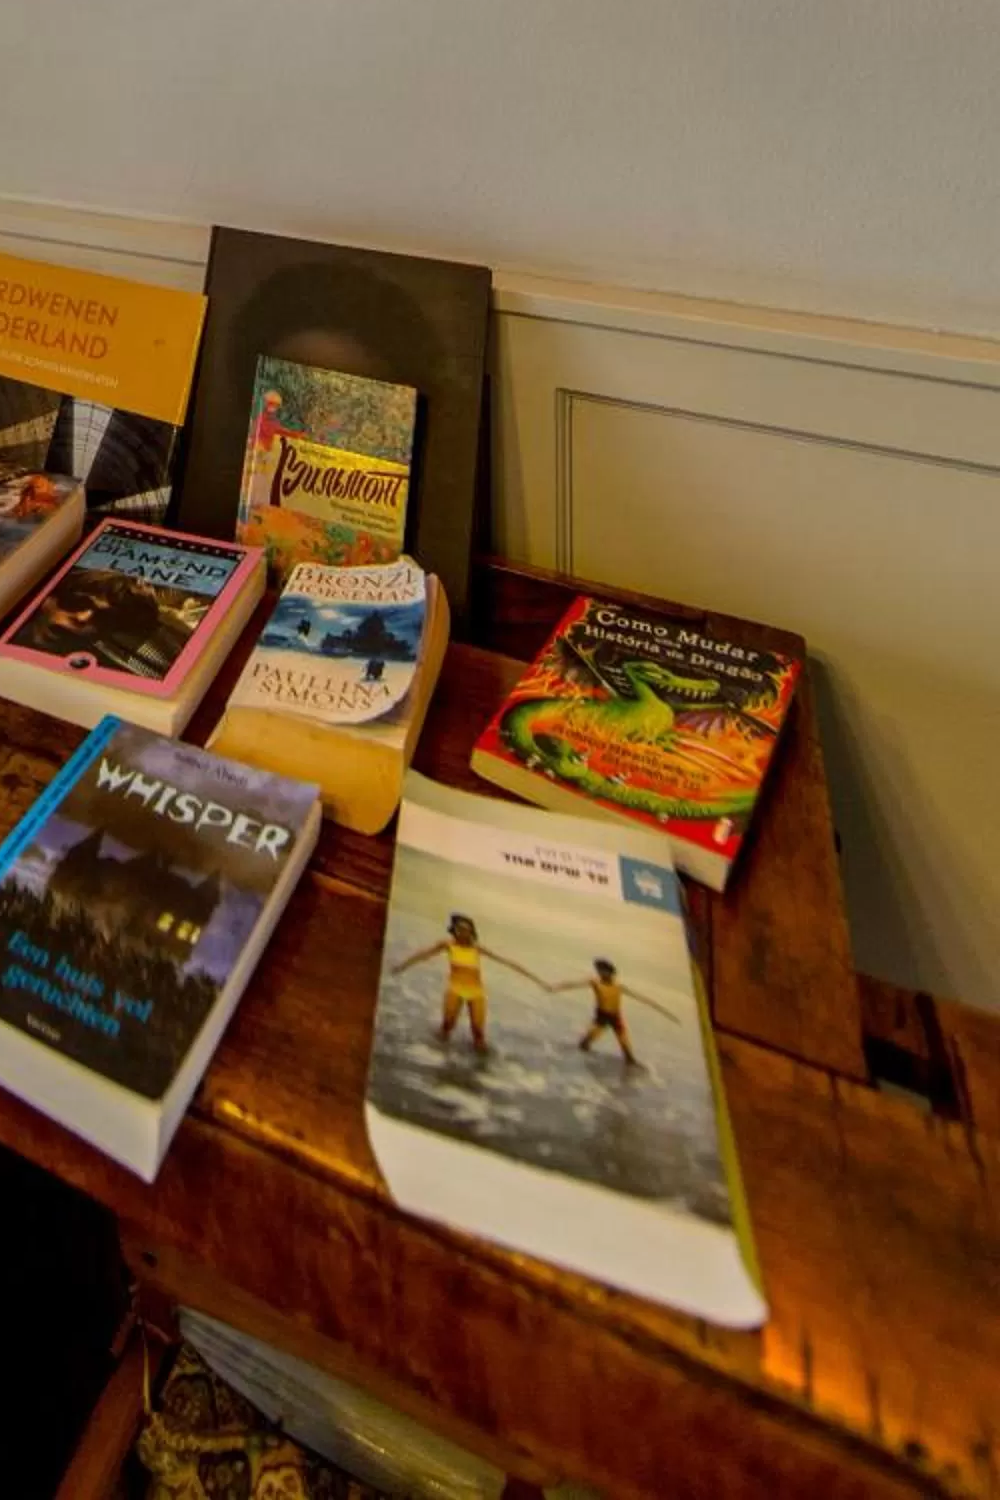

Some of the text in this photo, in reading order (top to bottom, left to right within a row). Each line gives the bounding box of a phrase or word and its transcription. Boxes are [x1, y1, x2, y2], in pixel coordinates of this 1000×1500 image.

[110, 559, 193, 587] LANE
[596, 609, 760, 663] Como Mudar
[252, 662, 391, 697] PAULLINA
[690, 651, 764, 683] Dragão
[259, 678, 373, 711] SIMONS
[96, 757, 289, 861] WHISPER
[8, 930, 49, 968] Een
